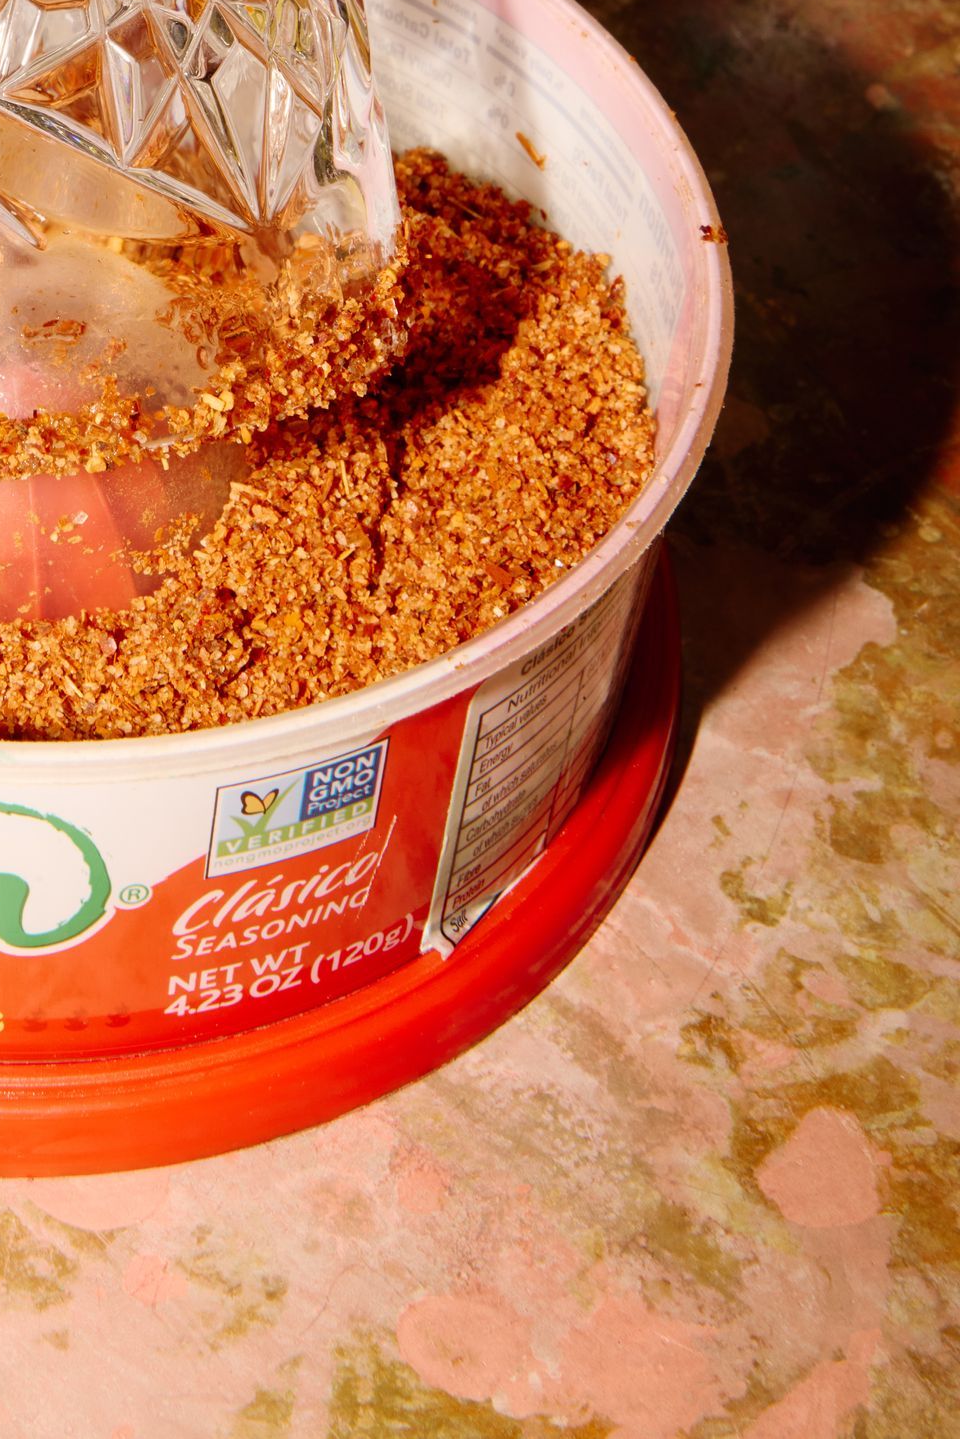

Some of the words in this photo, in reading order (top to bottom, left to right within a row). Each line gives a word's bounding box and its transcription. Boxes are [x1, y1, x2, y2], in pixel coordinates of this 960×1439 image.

[507, 644, 577, 713] Nutritional
[485, 716, 519, 749] Typical
[312, 751, 377, 787] NON
[479, 742, 513, 774] Energy
[307, 784, 372, 816] Project
[309, 768, 375, 802] GMO
[474, 777, 492, 797] Fat
[481, 792, 494, 812] of
[493, 773, 519, 802] which
[214, 816, 371, 868] nongmoproject.org
[225, 802, 368, 854] VERIFIED
[472, 840, 485, 857] of
[484, 819, 510, 847] which
[171, 851, 379, 937] Clásico
[452, 878, 485, 909] Protein
[456, 863, 482, 888] Fibre
[171, 885, 371, 960] SEASONING
[449, 908, 469, 933] Salt
[164, 983, 243, 1017] 4.23
[249, 966, 302, 996] OZ
[310, 912, 415, 985] (120g)
[167, 962, 242, 996] NET
[249, 941, 311, 976] WT
